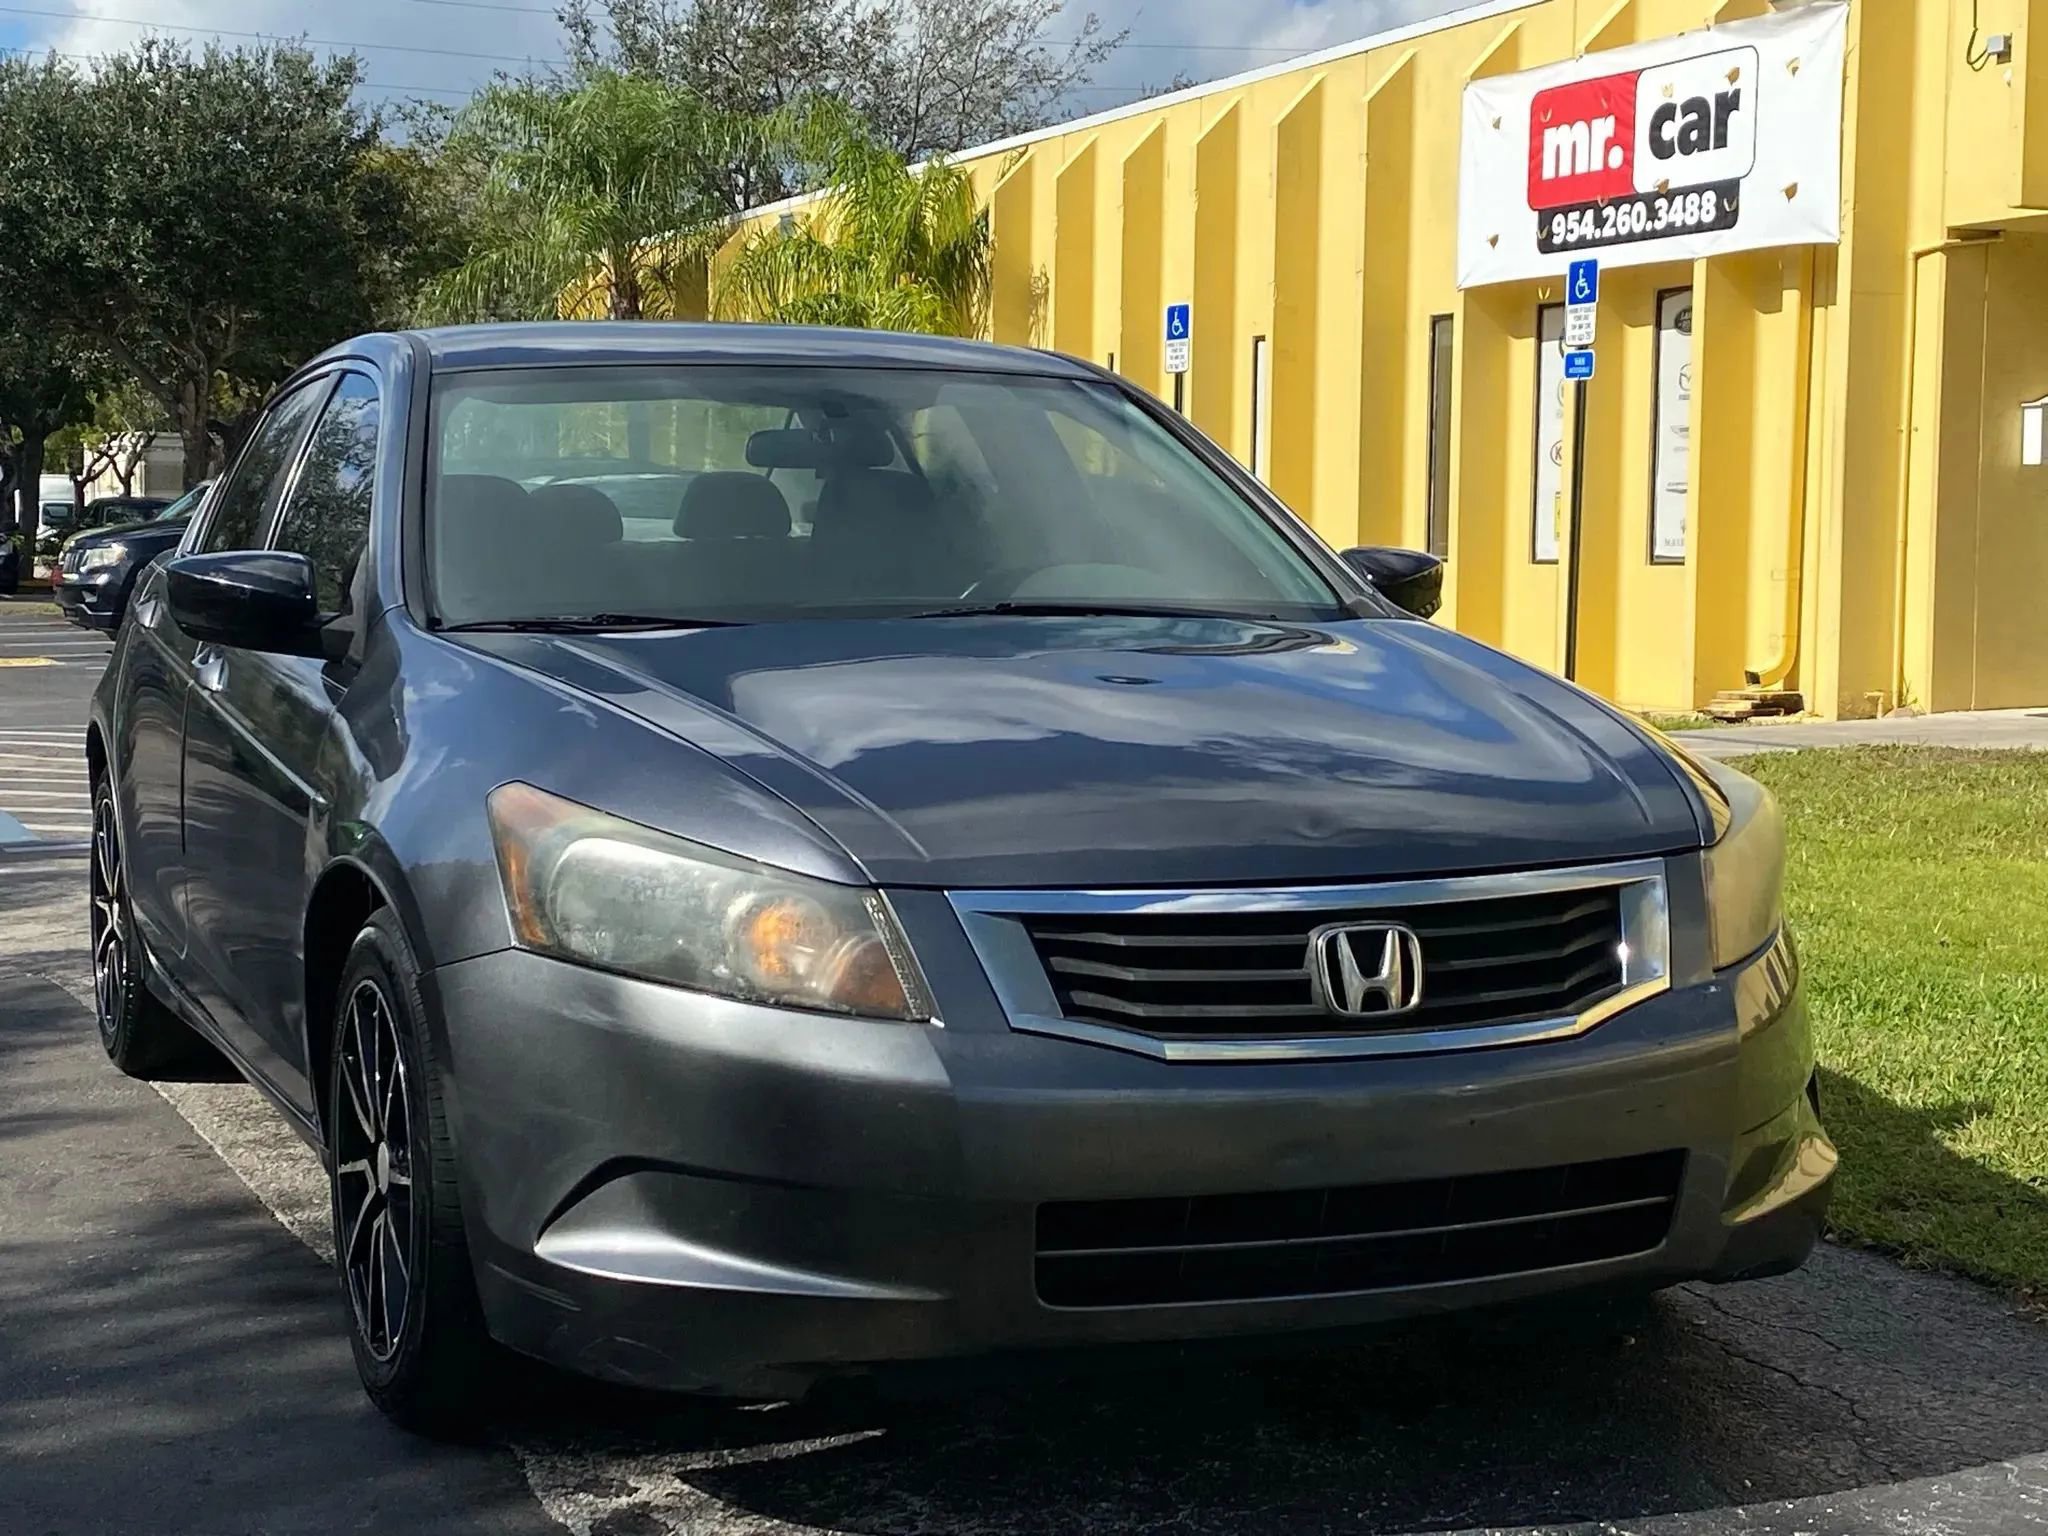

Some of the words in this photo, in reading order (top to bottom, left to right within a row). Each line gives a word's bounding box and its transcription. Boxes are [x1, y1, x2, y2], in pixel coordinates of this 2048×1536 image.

[1542, 114, 1624, 181] mr.
[1648, 87, 1741, 160] car
[1551, 191, 1717, 245] 954.260.3488
